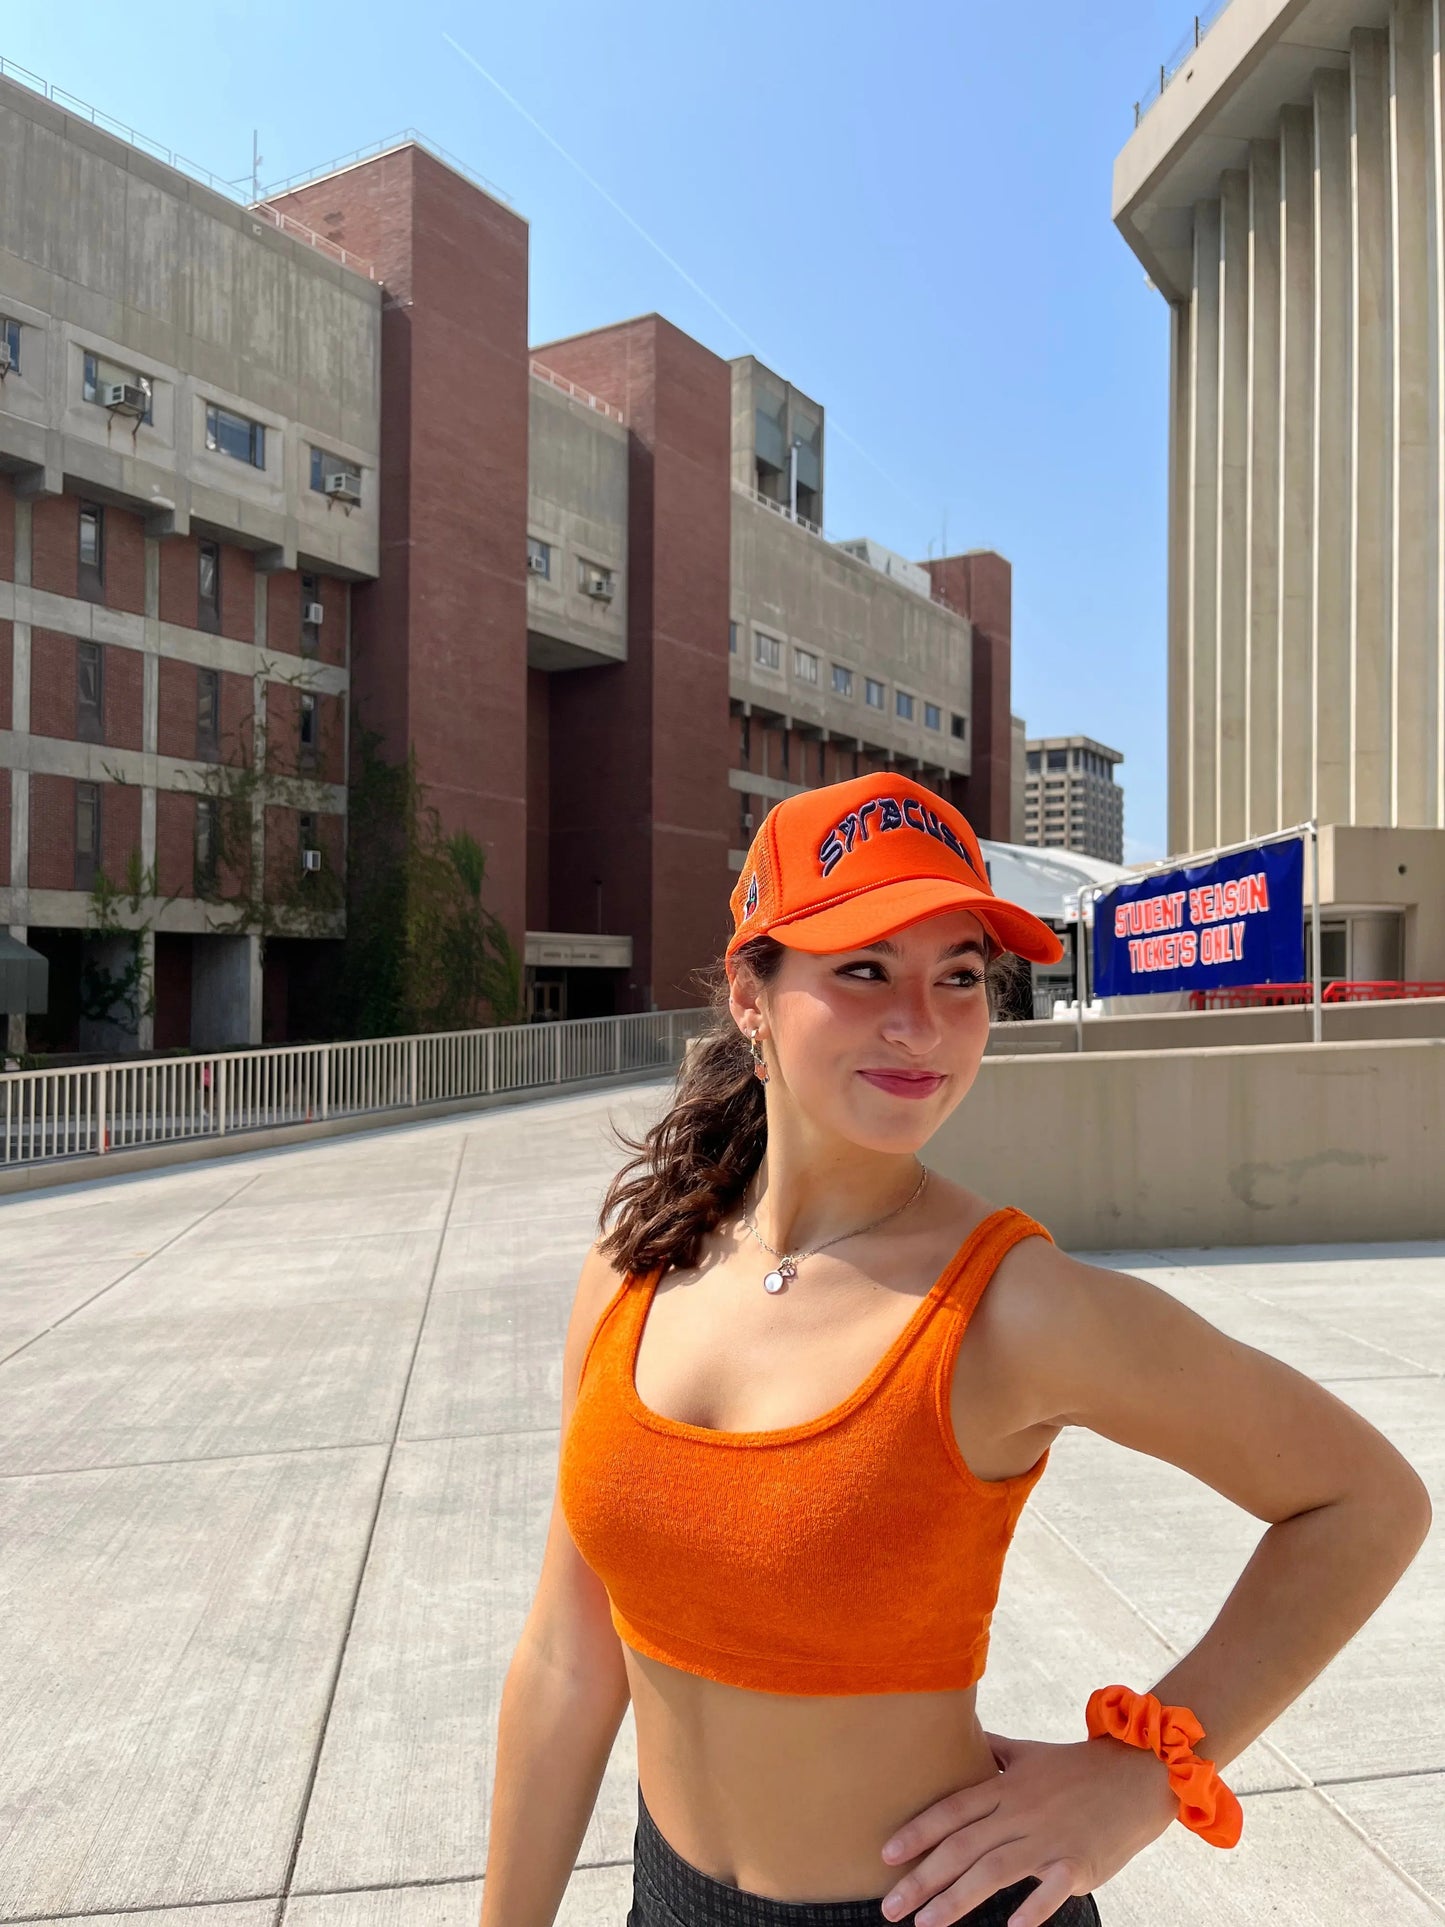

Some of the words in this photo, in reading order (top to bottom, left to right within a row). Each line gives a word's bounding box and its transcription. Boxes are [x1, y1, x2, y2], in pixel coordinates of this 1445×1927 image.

[1114, 891, 1186, 938] STUDENT
[1189, 872, 1270, 925] SEASON
[1128, 930, 1197, 974] TICKETS
[1200, 921, 1245, 965] ONLY
